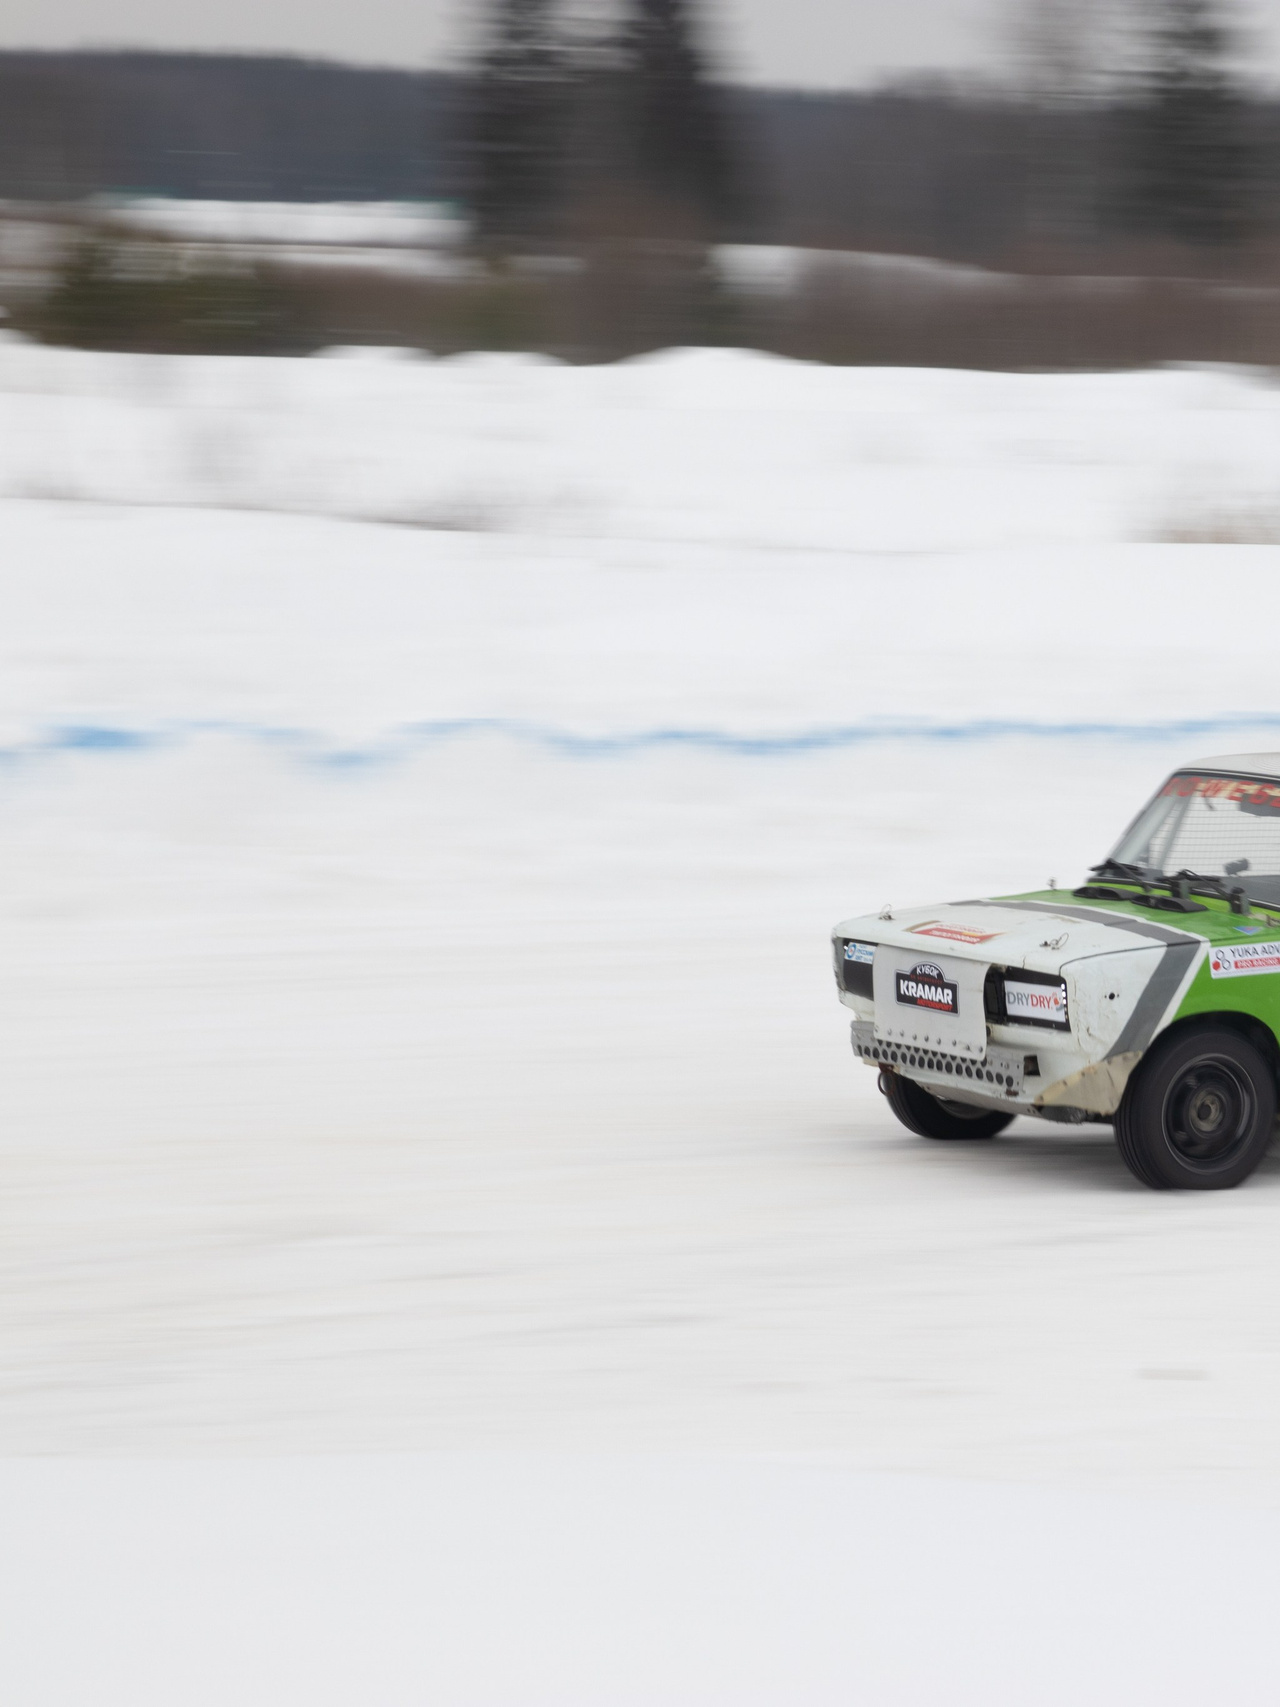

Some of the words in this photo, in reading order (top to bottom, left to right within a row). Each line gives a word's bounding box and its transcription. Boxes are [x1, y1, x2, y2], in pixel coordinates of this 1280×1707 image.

[1230, 946, 1259, 959] YUKA
[1261, 943, 1280, 955] ADV
[900, 979, 953, 1005] KRAMAR
